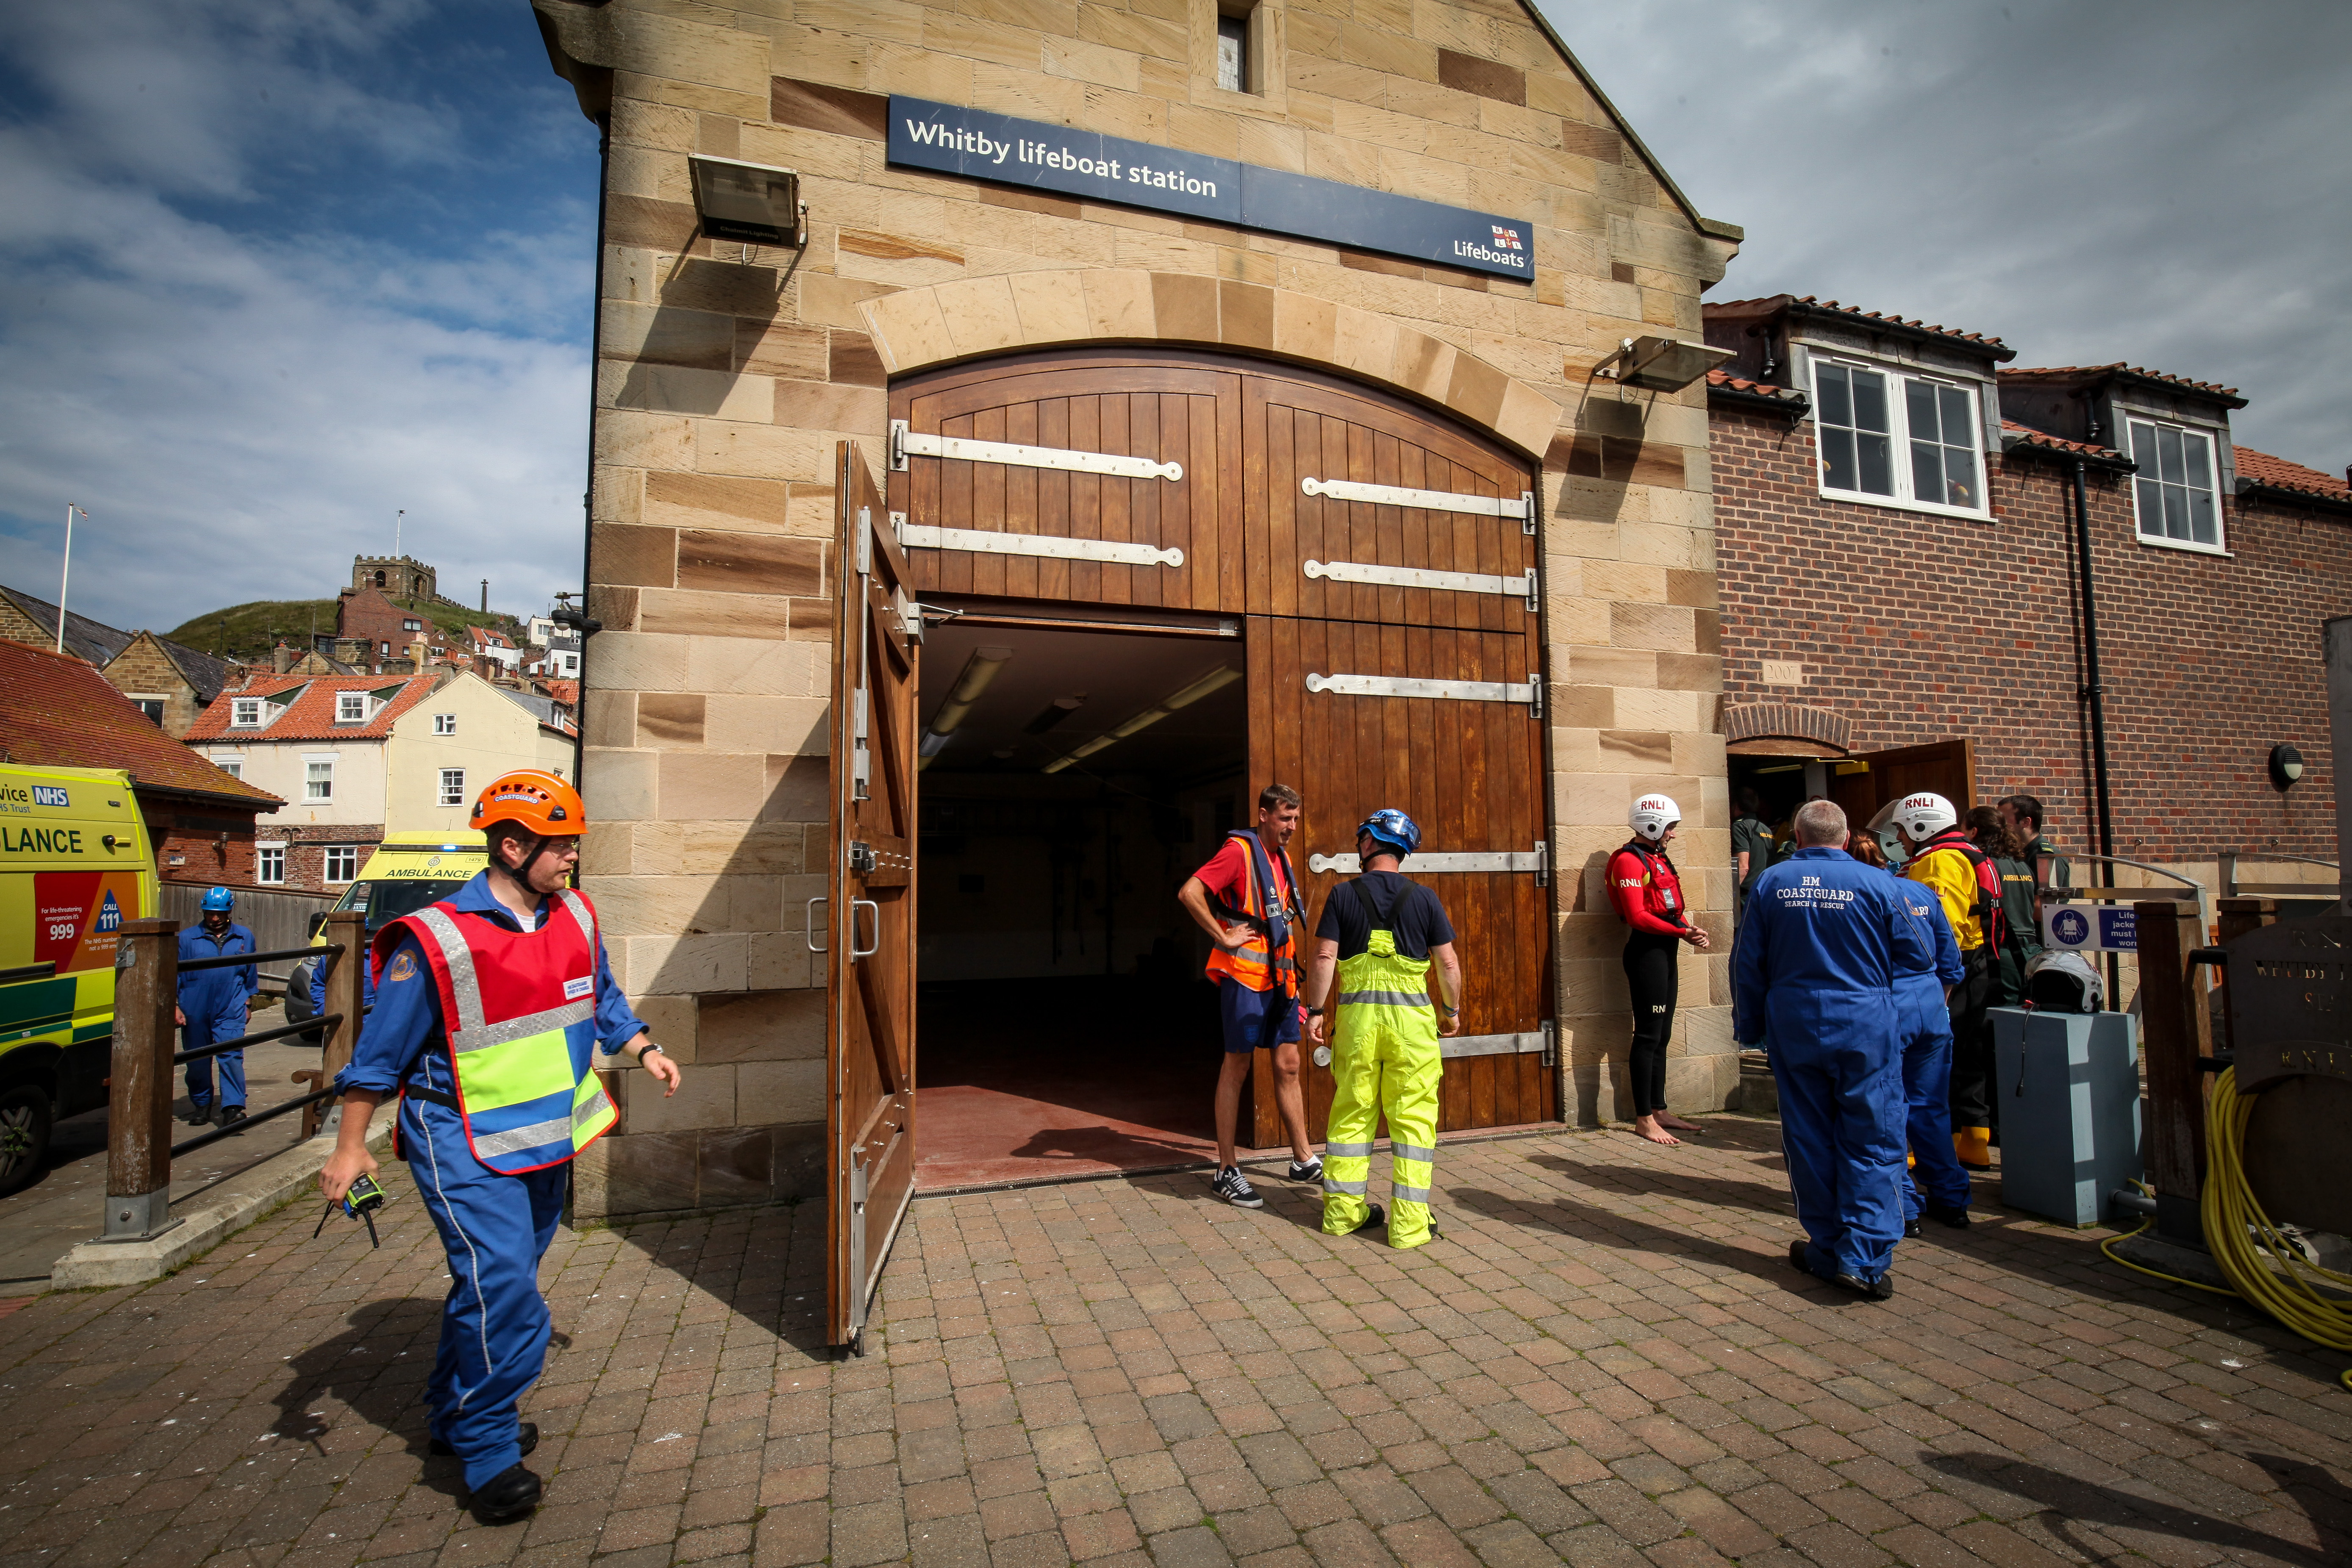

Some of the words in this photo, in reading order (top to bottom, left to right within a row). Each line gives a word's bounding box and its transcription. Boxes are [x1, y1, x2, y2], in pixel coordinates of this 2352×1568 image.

[906, 119, 1010, 164] Whitby
[1019, 139, 1121, 180] lifeboat
[1129, 166, 1216, 198] station
[749, 230, 778, 239] Lighting
[1455, 240, 1524, 268] Lifeboats
[1766, 664, 1797, 680] 2007
[35, 787, 67, 805] NHS
[494, 794, 539, 804] COASTGUARD
[10, 804, 31, 813] Trust
[1641, 800, 1665, 811] RNLI
[1905, 797, 1933, 810] RNLI
[0, 827, 83, 853] LANCE
[385, 869, 472, 878] AMBULANCE
[1619, 878, 1641, 888] RNLI
[1802, 876, 1820, 886] HM
[1777, 888, 1854, 901] COASTGUARD
[1820, 902, 1844, 910] RESCUE
[101, 913, 119, 929] 111
[2113, 921, 2135, 929] jacke
[50, 924, 75, 941] 999
[2254, 960, 2329, 980] WHITBY
